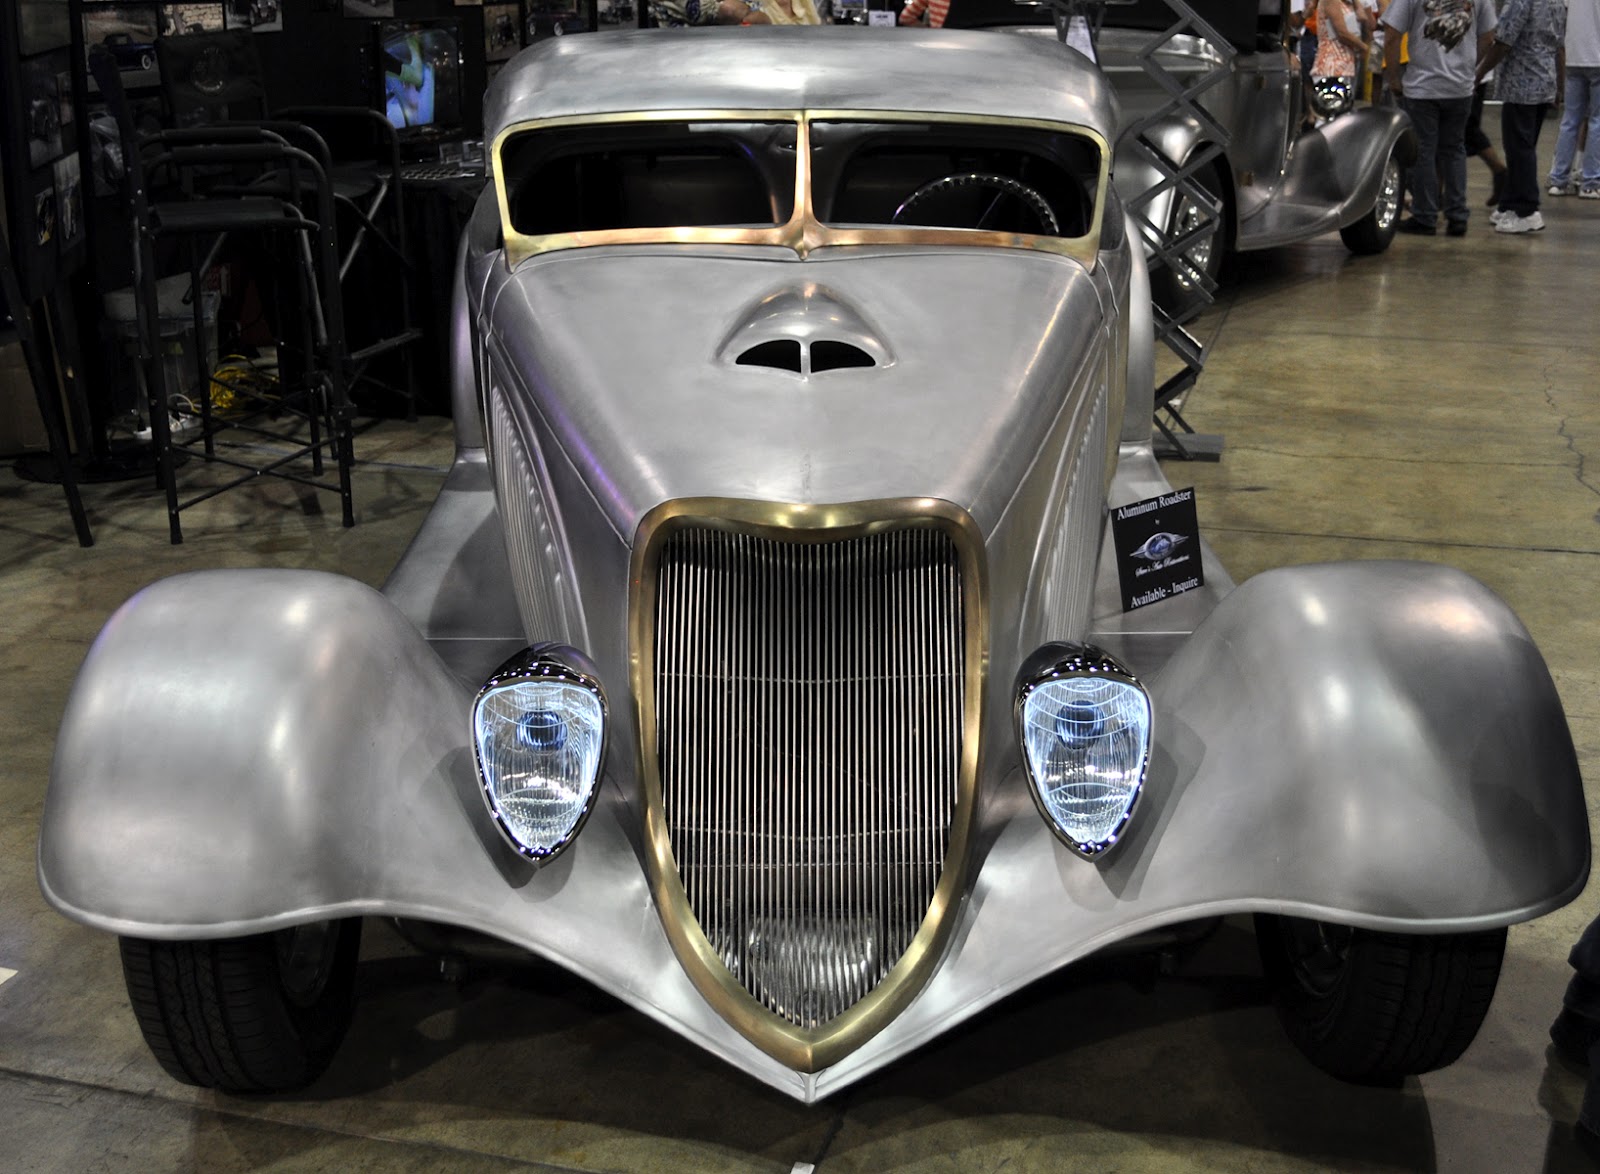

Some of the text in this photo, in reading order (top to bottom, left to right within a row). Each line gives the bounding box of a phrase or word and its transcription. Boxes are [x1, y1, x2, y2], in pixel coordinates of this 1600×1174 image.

[1117, 491, 1191, 520] Aluminum Roadster
[1130, 587, 1166, 608] Available
[1172, 577, 1198, 593] Inquire
